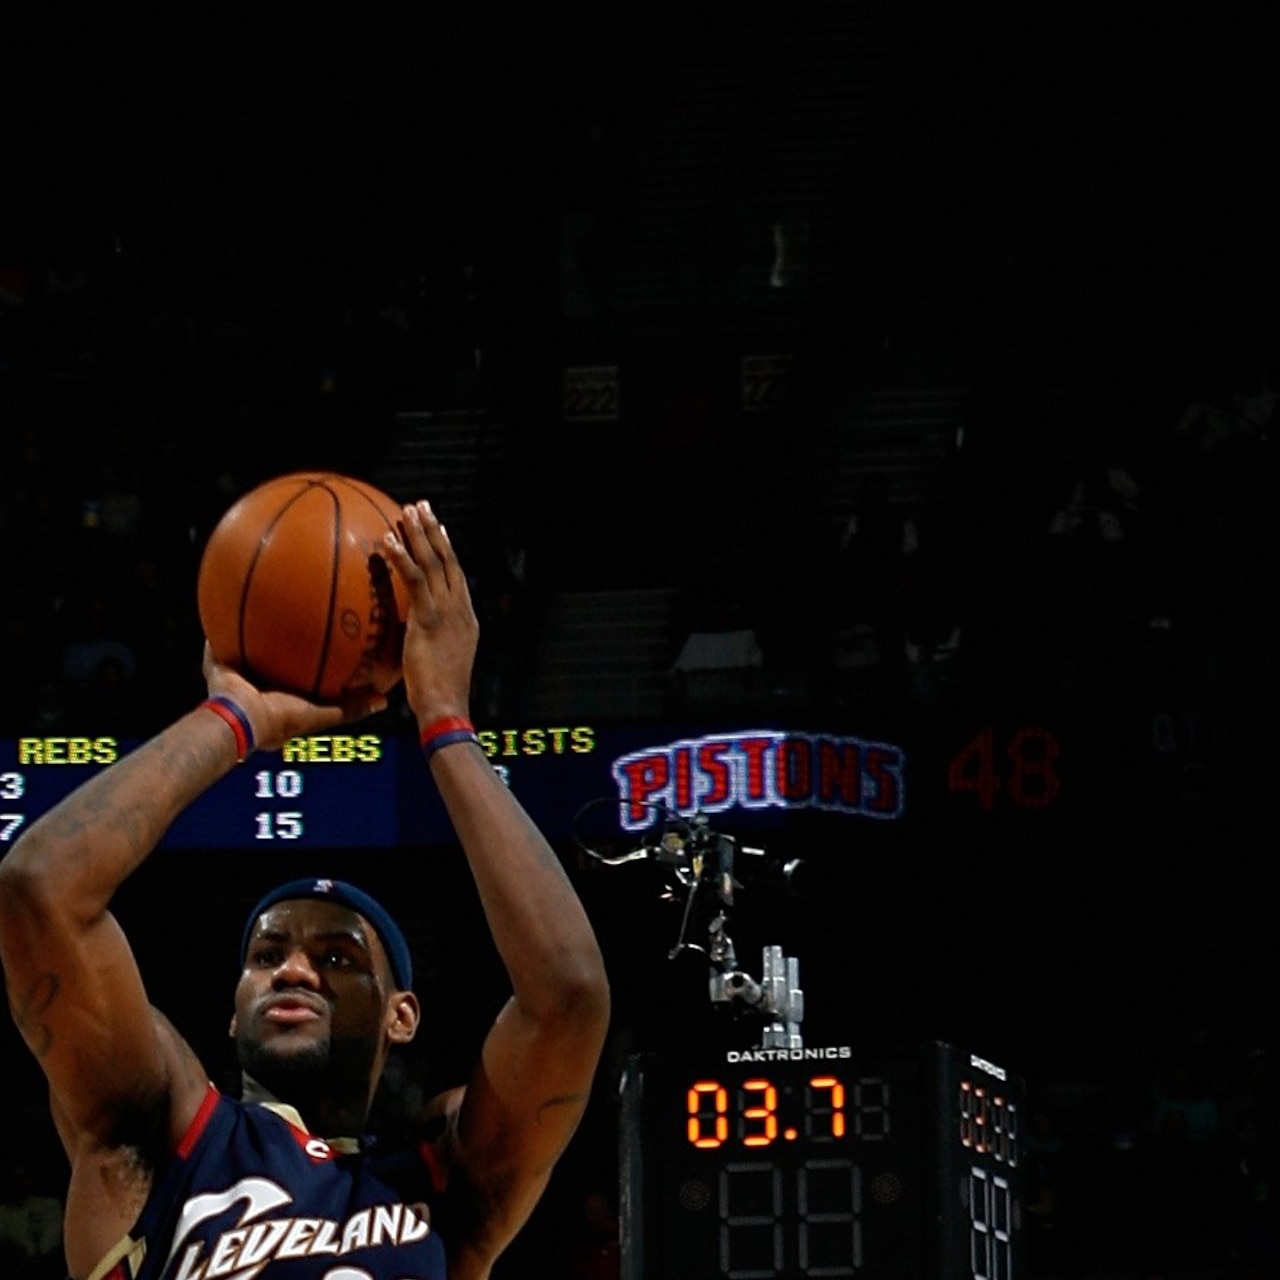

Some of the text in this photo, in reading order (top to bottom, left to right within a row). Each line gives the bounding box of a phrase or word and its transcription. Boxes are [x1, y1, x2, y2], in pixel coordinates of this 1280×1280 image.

[19, 737, 117, 764] REBS
[283, 735, 383, 763] REBS
[477, 725, 597, 757] SISTS
[255, 770, 303, 798] 10
[612, 730, 906, 832] PISTONS
[255, 813, 303, 839] 15
[727, 1047, 851, 1063] DAKTRONICS
[687, 1077, 846, 1149] 03.7
